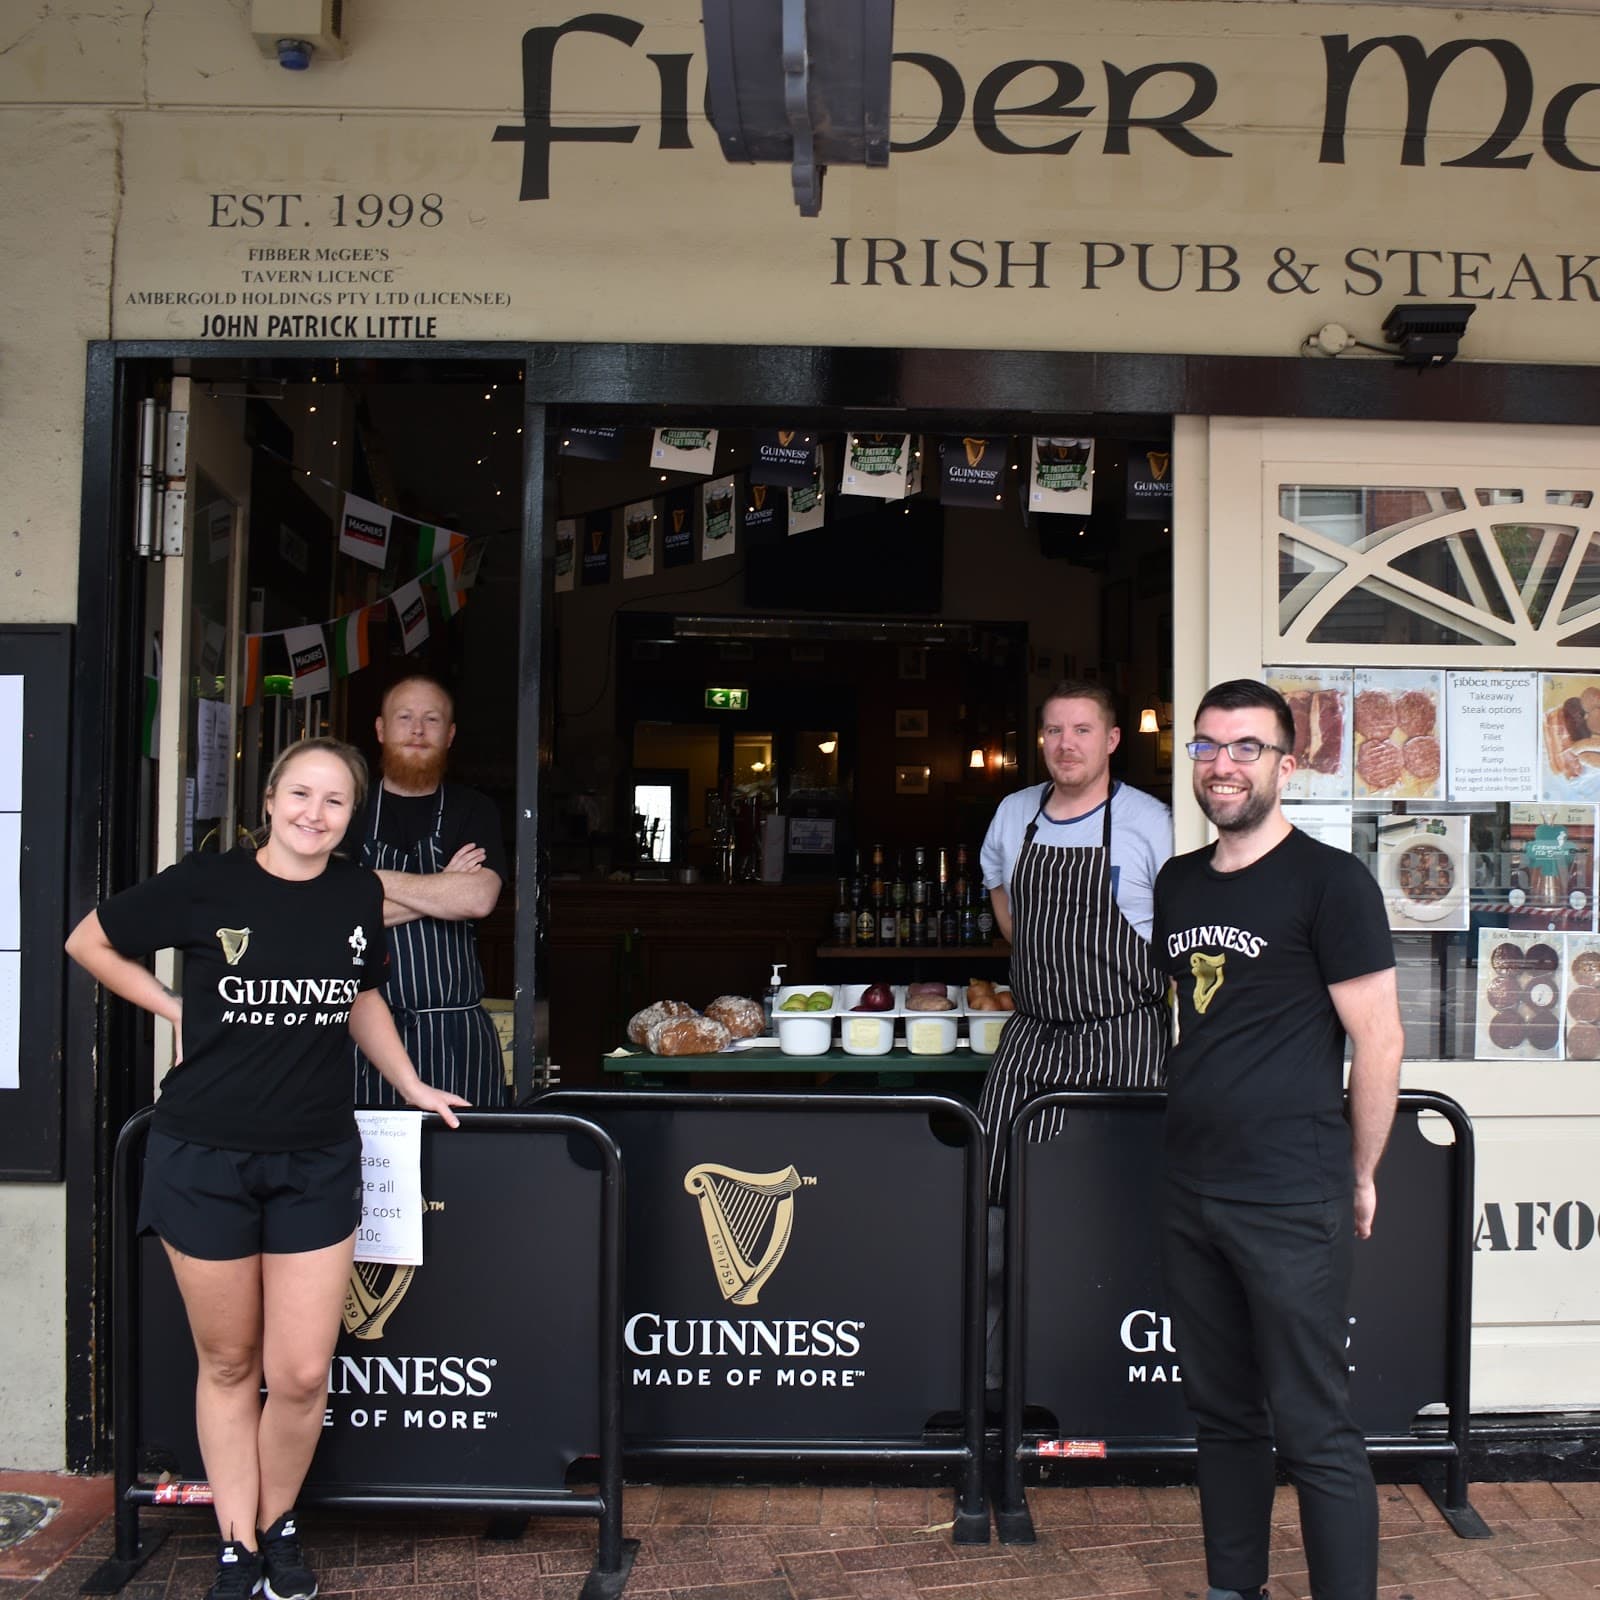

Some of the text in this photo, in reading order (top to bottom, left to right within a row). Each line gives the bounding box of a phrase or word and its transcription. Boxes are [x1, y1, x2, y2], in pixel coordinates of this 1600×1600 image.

[208, 193, 444, 228] EST. 1998
[248, 248, 310, 261] FIBBER
[829, 237, 1051, 289] IRISH
[1080, 241, 1241, 293] PUB
[1266, 246, 1320, 294] &
[241, 270, 394, 283] TAVERN LICENCE
[126, 292, 511, 307] AMBERGOLD HOLDINGS PTY LTD (LICENSEE)
[201, 314, 437, 338] JOHN PATRICK LITTLE
[760, 445, 808, 460] GUINNESS
[949, 466, 996, 479] GUINNESS
[1134, 480, 1173, 491] GUINNE
[1470, 691, 1514, 702] Takeaway
[1462, 706, 1522, 716] Steak options
[1167, 925, 1261, 958] GUINNESS
[218, 976, 360, 1005] GUINNESS
[221, 1010, 275, 1025] MADE
[284, 1013, 308, 1025] OF
[379, 1181, 394, 1193] all
[373, 1207, 402, 1219] cost
[358, 1228, 381, 1242] 10c
[718, 1258, 735, 1285] 1759
[624, 1313, 861, 1356] GUINNESS
[328, 1357, 493, 1396] INNESS
[633, 1369, 711, 1386] MADE
[726, 1368, 762, 1386] OF
[351, 1409, 387, 1427] OF
